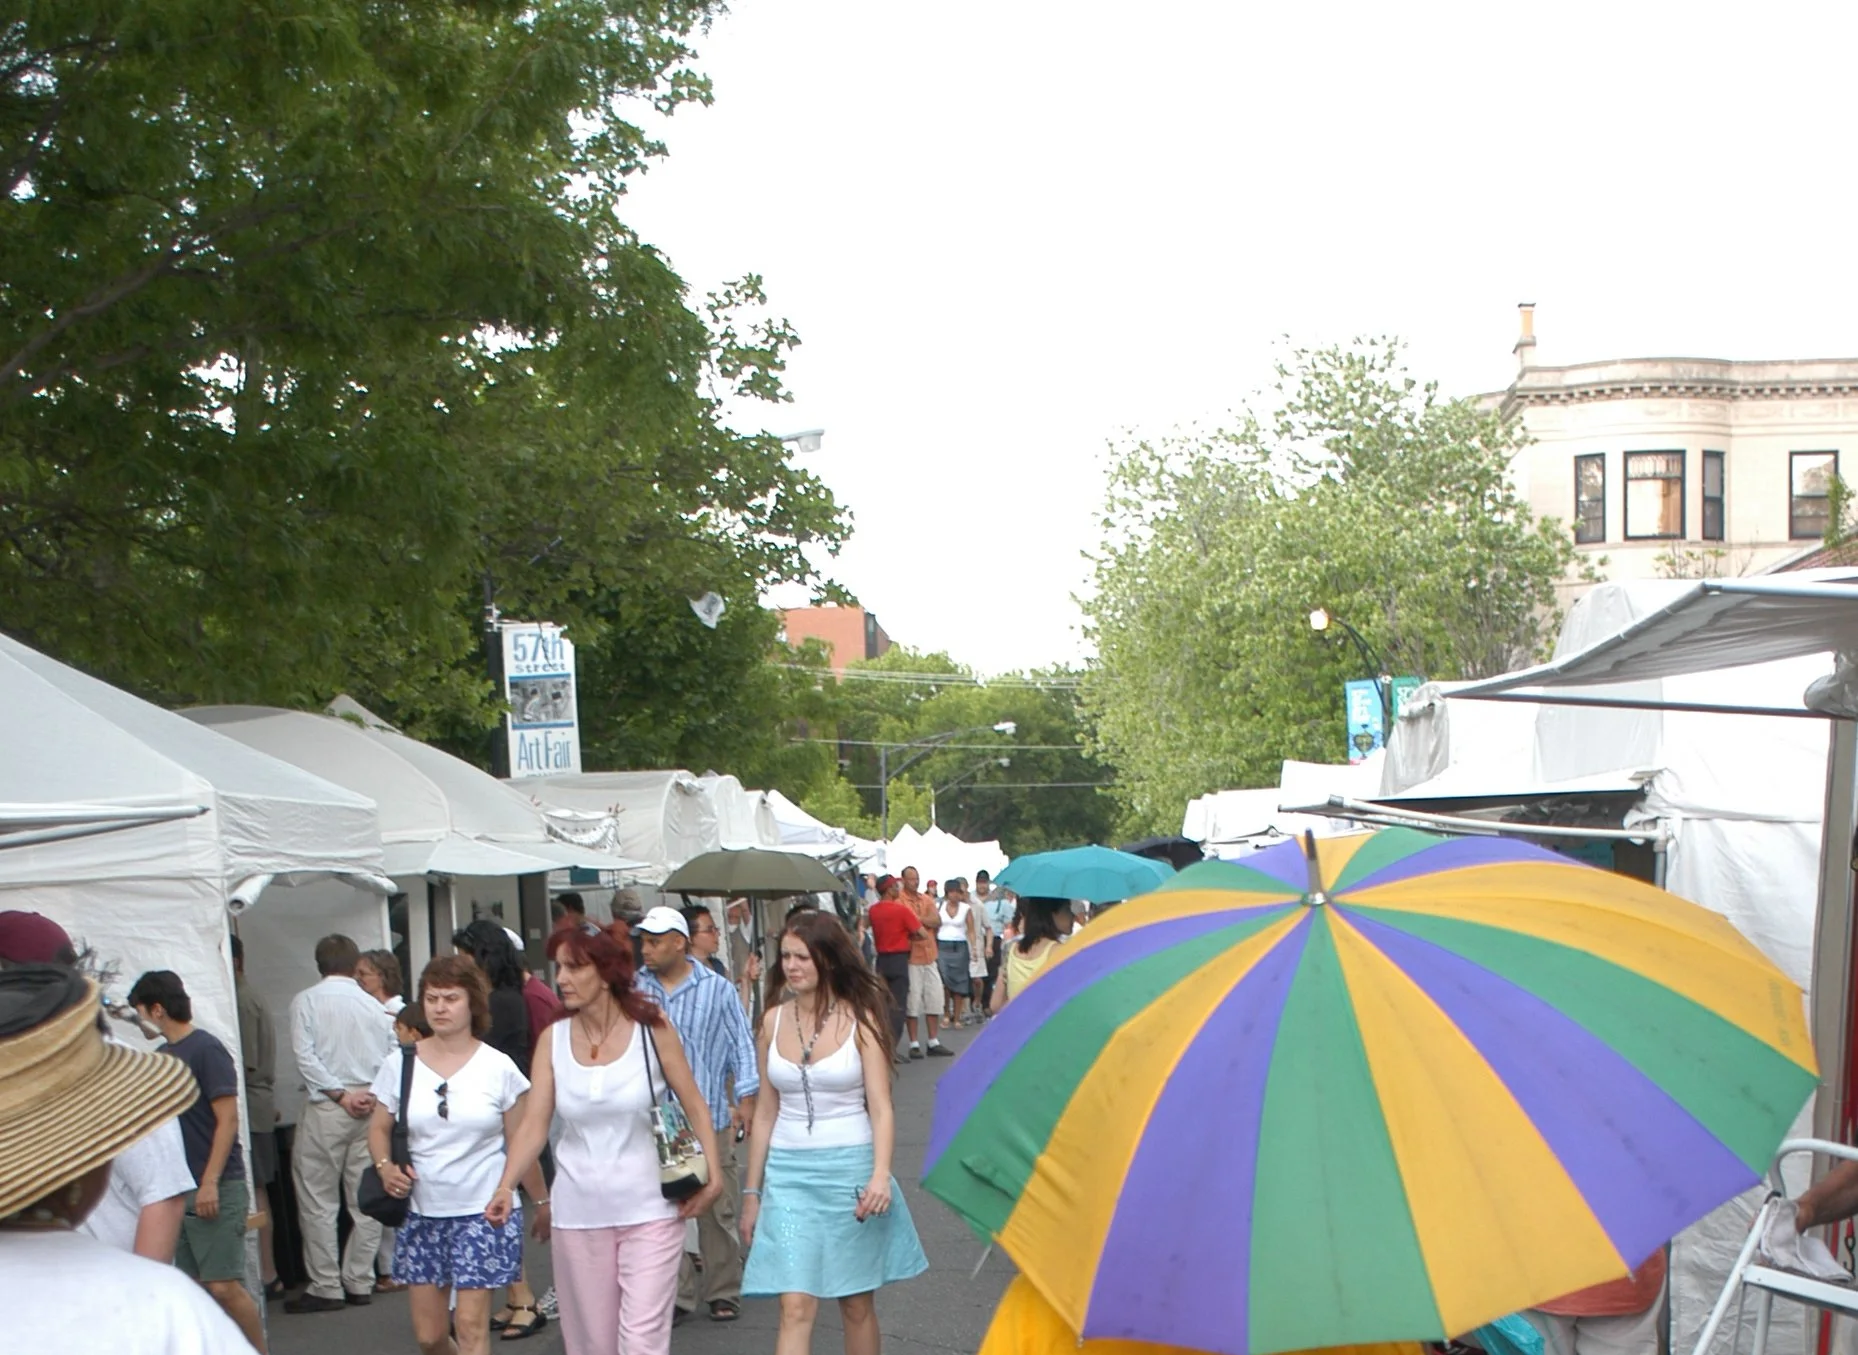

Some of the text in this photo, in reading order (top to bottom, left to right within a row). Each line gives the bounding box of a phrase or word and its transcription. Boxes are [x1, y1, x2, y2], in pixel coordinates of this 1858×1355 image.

[513, 632, 564, 663] 57th
[517, 731, 571, 771] Art Fair
